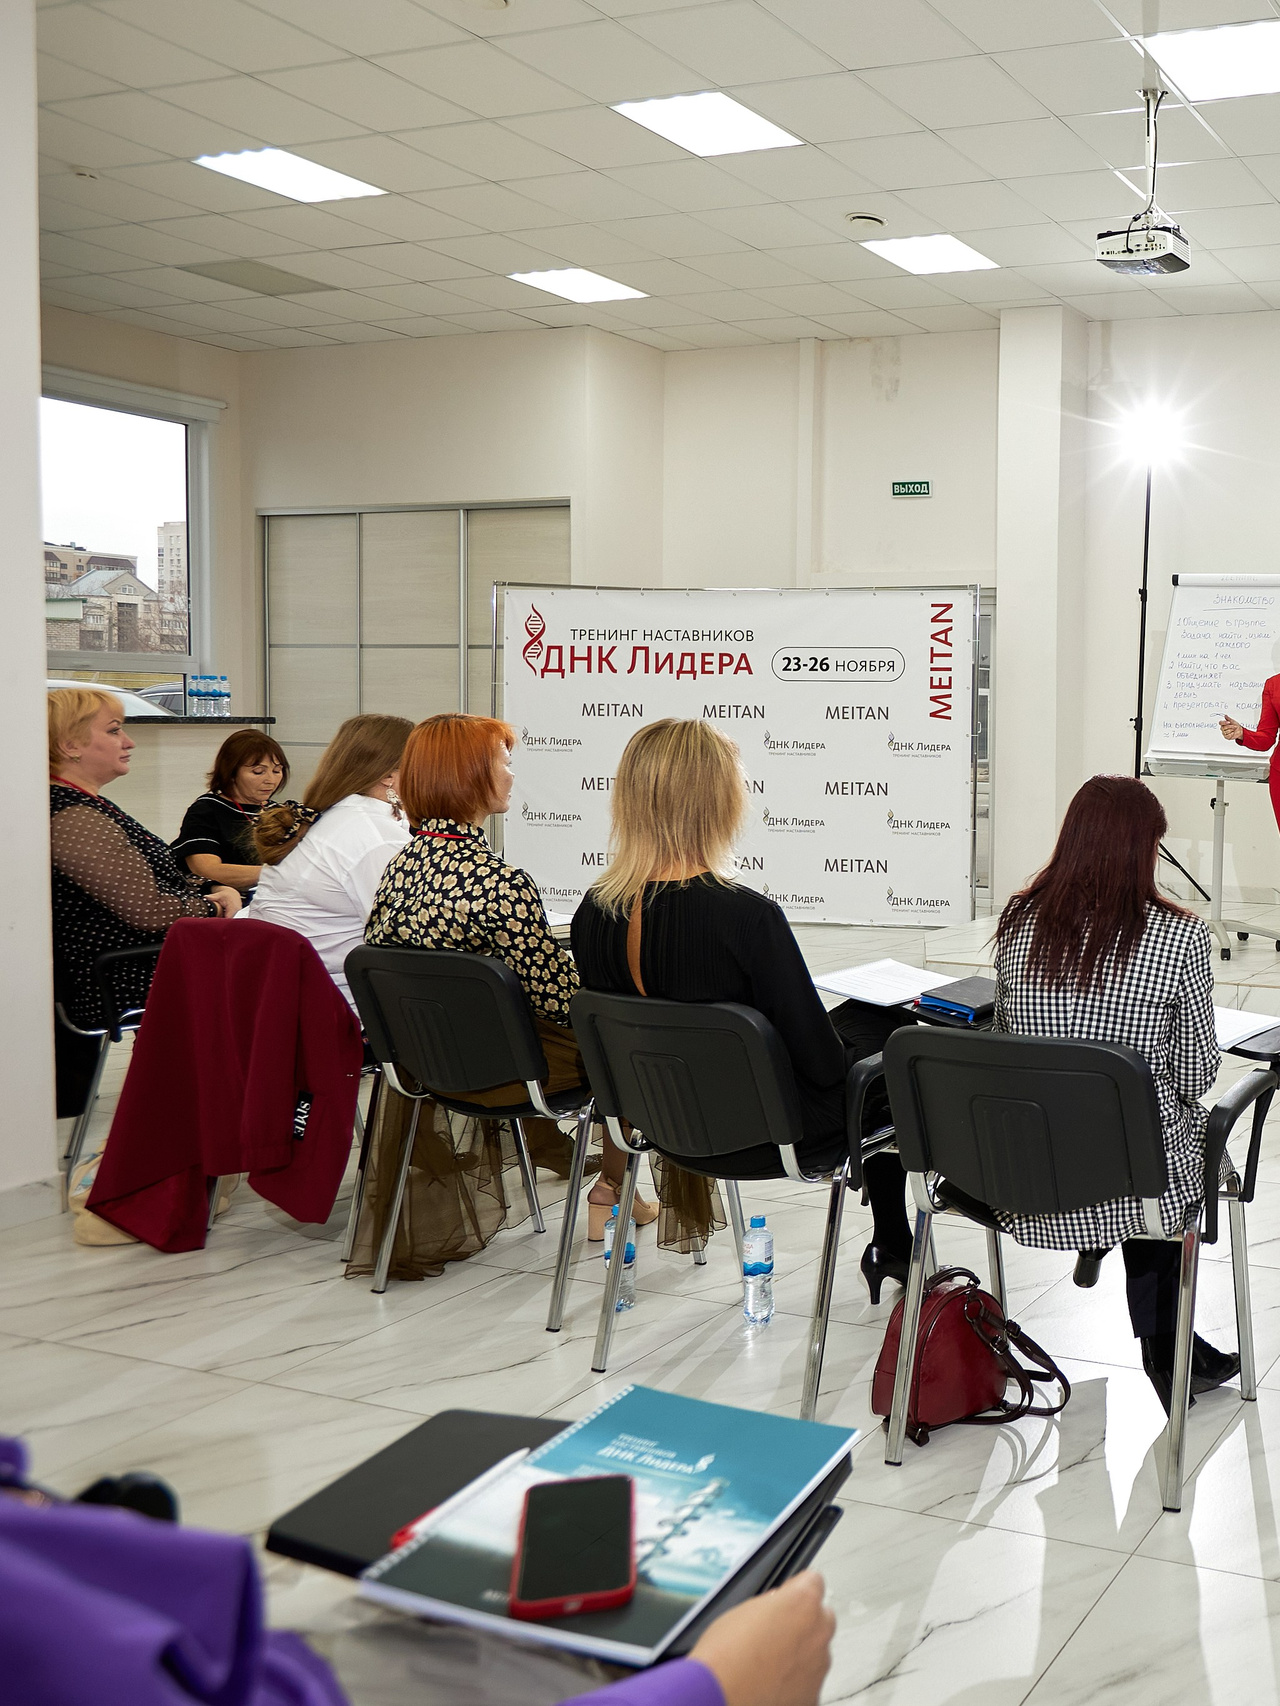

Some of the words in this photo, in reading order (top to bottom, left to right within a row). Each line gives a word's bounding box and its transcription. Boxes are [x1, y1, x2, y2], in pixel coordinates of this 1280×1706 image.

[893, 483, 929, 494] ВЫХОД
[570, 628, 638, 642] ТРЕНИНГ
[642, 629, 755, 642] НАСТАВНИКОВ
[541, 645, 617, 680] ДНК
[782, 656, 831, 673] 23-26
[836, 659, 895, 673] НОЯБРЯ
[929, 603, 953, 721] MEITAN
[581, 703, 643, 718] MEITAN
[702, 704, 765, 719] MEITAN
[825, 706, 889, 720] MEITAN
[526, 736, 547, 746] ДНК
[769, 740, 790, 750] ДНК
[893, 742, 914, 752] ДНК
[825, 781, 889, 797] MEITAN
[526, 812, 547, 821] ДНК
[768, 817, 789, 827] ДНК
[892, 820, 914, 829] ДНК
[824, 858, 888, 874] MEITAN
[892, 897, 914, 907] ДНК
